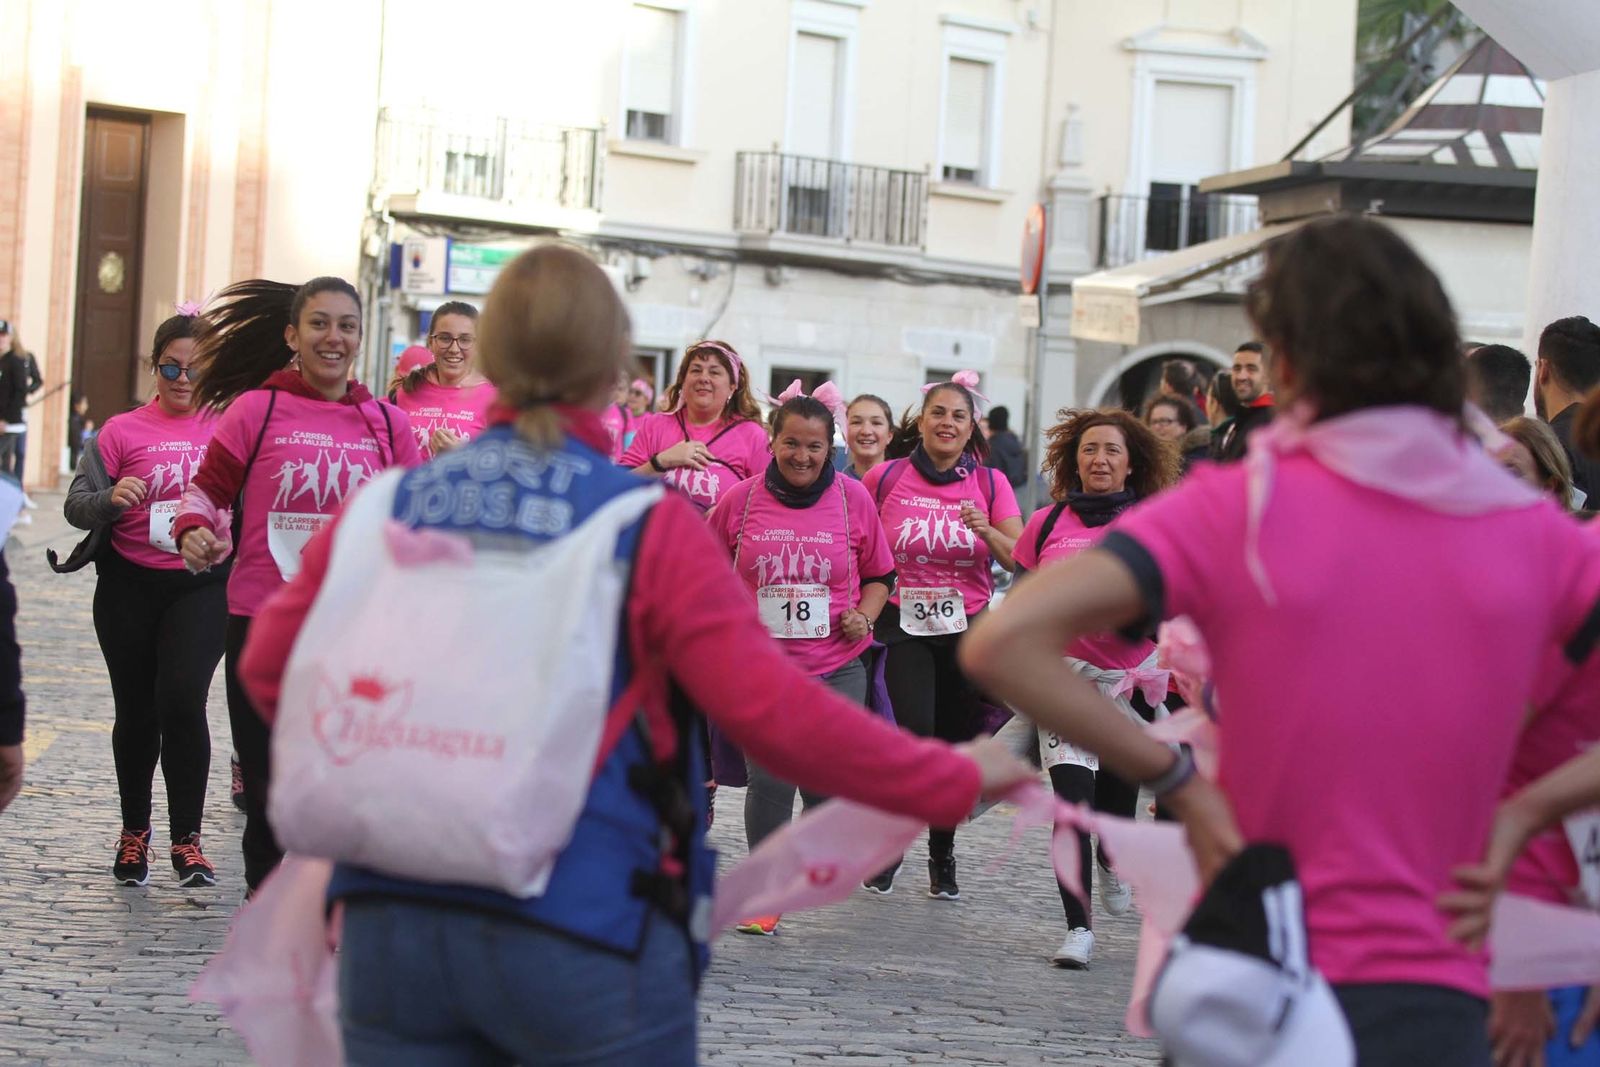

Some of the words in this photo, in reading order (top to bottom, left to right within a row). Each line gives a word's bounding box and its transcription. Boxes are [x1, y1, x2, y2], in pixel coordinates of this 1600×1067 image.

[292, 430, 333, 442] CARRERA
[274, 437, 288, 445] DE
[288, 437, 301, 445] LA
[302, 439, 334, 448] MUJER
[912, 496, 941, 505] CARRERA
[919, 502, 941, 510] MUJER
[287, 516, 321, 525] CARRERA
[273, 522, 284, 530] DE
[284, 522, 295, 531] LA
[764, 528, 795, 536] CARRERA
[816, 531, 833, 539] PINK
[752, 534, 760, 542] DE
[761, 534, 770, 542] LA
[801, 536, 834, 544] RUNNING
[780, 600, 811, 622] 18
[913, 600, 955, 620] 346
